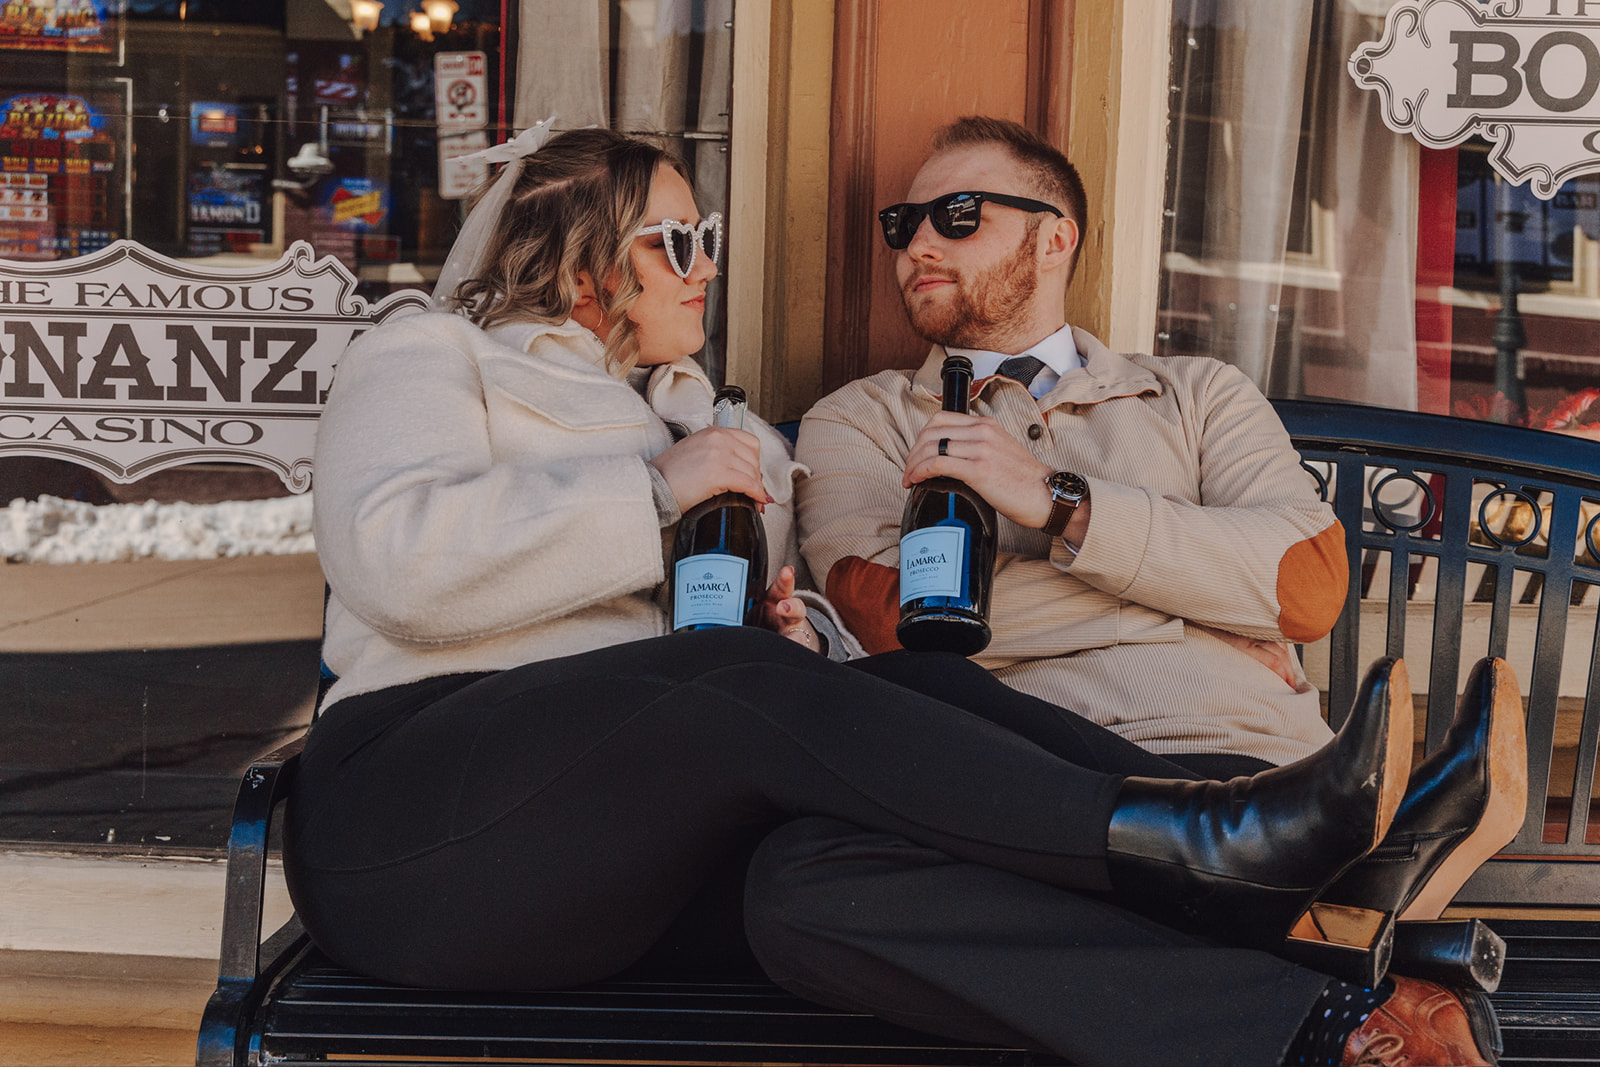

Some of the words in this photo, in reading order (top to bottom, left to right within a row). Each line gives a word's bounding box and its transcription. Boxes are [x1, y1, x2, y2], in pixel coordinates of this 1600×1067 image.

[1447, 31, 1600, 113] BO
[74, 282, 314, 312] FAMOUS
[0, 320, 366, 404] NANZ
[0, 414, 264, 446] CASINO
